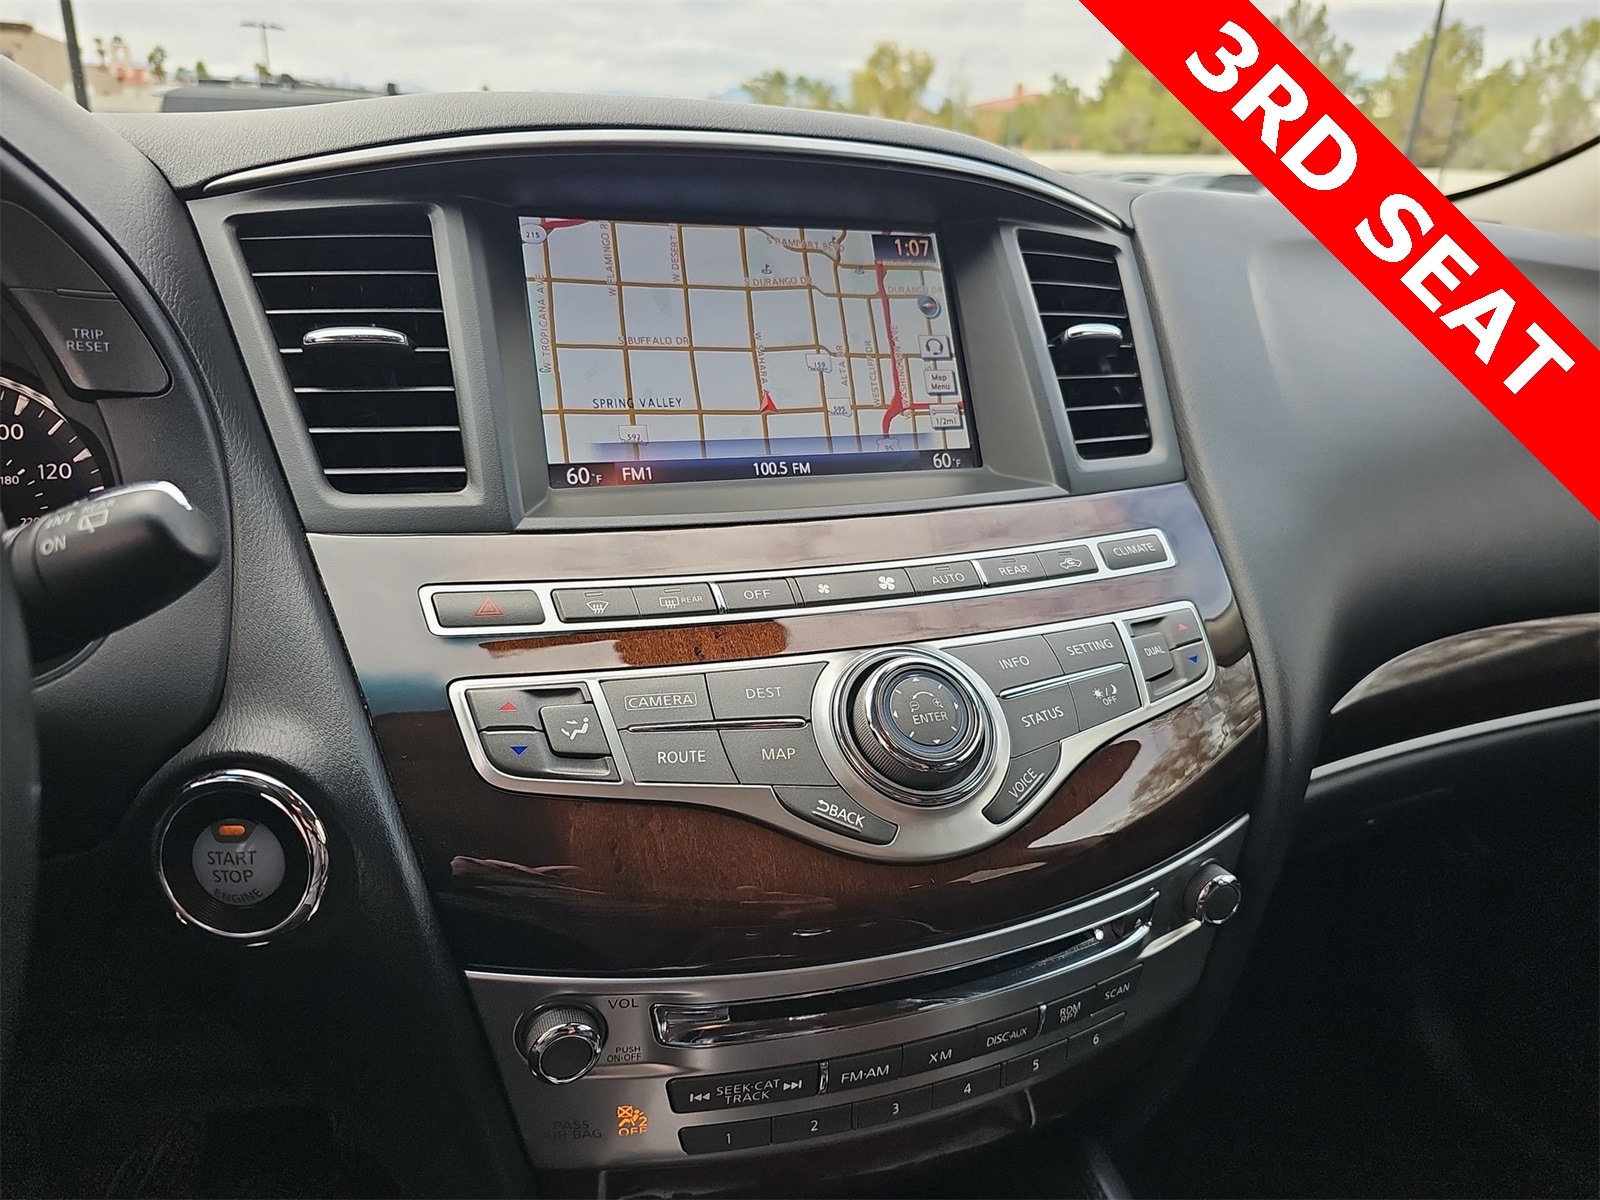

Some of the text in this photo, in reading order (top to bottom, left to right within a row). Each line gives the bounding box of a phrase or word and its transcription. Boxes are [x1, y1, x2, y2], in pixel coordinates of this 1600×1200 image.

[525, 231, 541, 239] 215
[670, 234, 680, 270] DESERT
[894, 239, 929, 257] 1:07
[601, 232, 616, 285] FLAMINGO
[534, 274, 546, 294] AVE
[672, 273, 681, 282] W
[744, 276, 813, 287] S DURANGO DR
[609, 288, 617, 296] W
[72, 328, 104, 340] TRIP
[538, 300, 551, 356] TROPICANA
[66, 340, 110, 352] RESET
[618, 336, 690, 345] S BUFFALO DR
[756, 346, 769, 385] SAHARA
[813, 361, 826, 369] 159
[838, 359, 849, 387] ALTA
[931, 374, 948, 382] Map
[592, 397, 682, 409] SPRING VALLEY
[37, 462, 73, 480] 120
[622, 466, 653, 482] FM1
[752, 461, 811, 476] 100.5 FM
[41, 533, 67, 556] ON
[1112, 542, 1155, 557] CLIMATE
[998, 564, 1030, 577] REAR
[931, 572, 965, 586] AUTO
[680, 595, 704, 604] REAR
[743, 589, 771, 600] OFF
[1065, 638, 1114, 656] SETTING
[1143, 645, 1166, 657] DUAL
[998, 655, 1030, 670] INFO
[745, 686, 782, 699] DEST
[628, 694, 694, 709] CAMERA
[1102, 695, 1118, 706] OFF
[912, 711, 949, 725] ENTER
[1020, 706, 1064, 728] STATUS
[657, 750, 707, 764] ROUTE
[761, 748, 796, 760] MAP
[1007, 767, 1039, 799] VOICE
[828, 804, 866, 828] BACK
[207, 850, 257, 865] START
[212, 869, 254, 884] STOP
[214, 887, 264, 903] ENGINE
[1104, 983, 1131, 1001] SCAN
[607, 998, 640, 1010] VOL
[1059, 1001, 1082, 1017] RDM
[1092, 1032, 1100, 1045] 6
[615, 1045, 641, 1054] PUSH
[928, 1048, 953, 1064] XM
[1032, 1058, 1040, 1071] 5
[963, 1082, 972, 1094] 4
[725, 1090, 770, 1105] TRACK
[892, 1102, 900, 1114] 3
[618, 1127, 648, 1137] OFF
[810, 1120, 819, 1132] 2
[572, 1129, 602, 1140] BAG
[726, 1133, 732, 1145] 1
